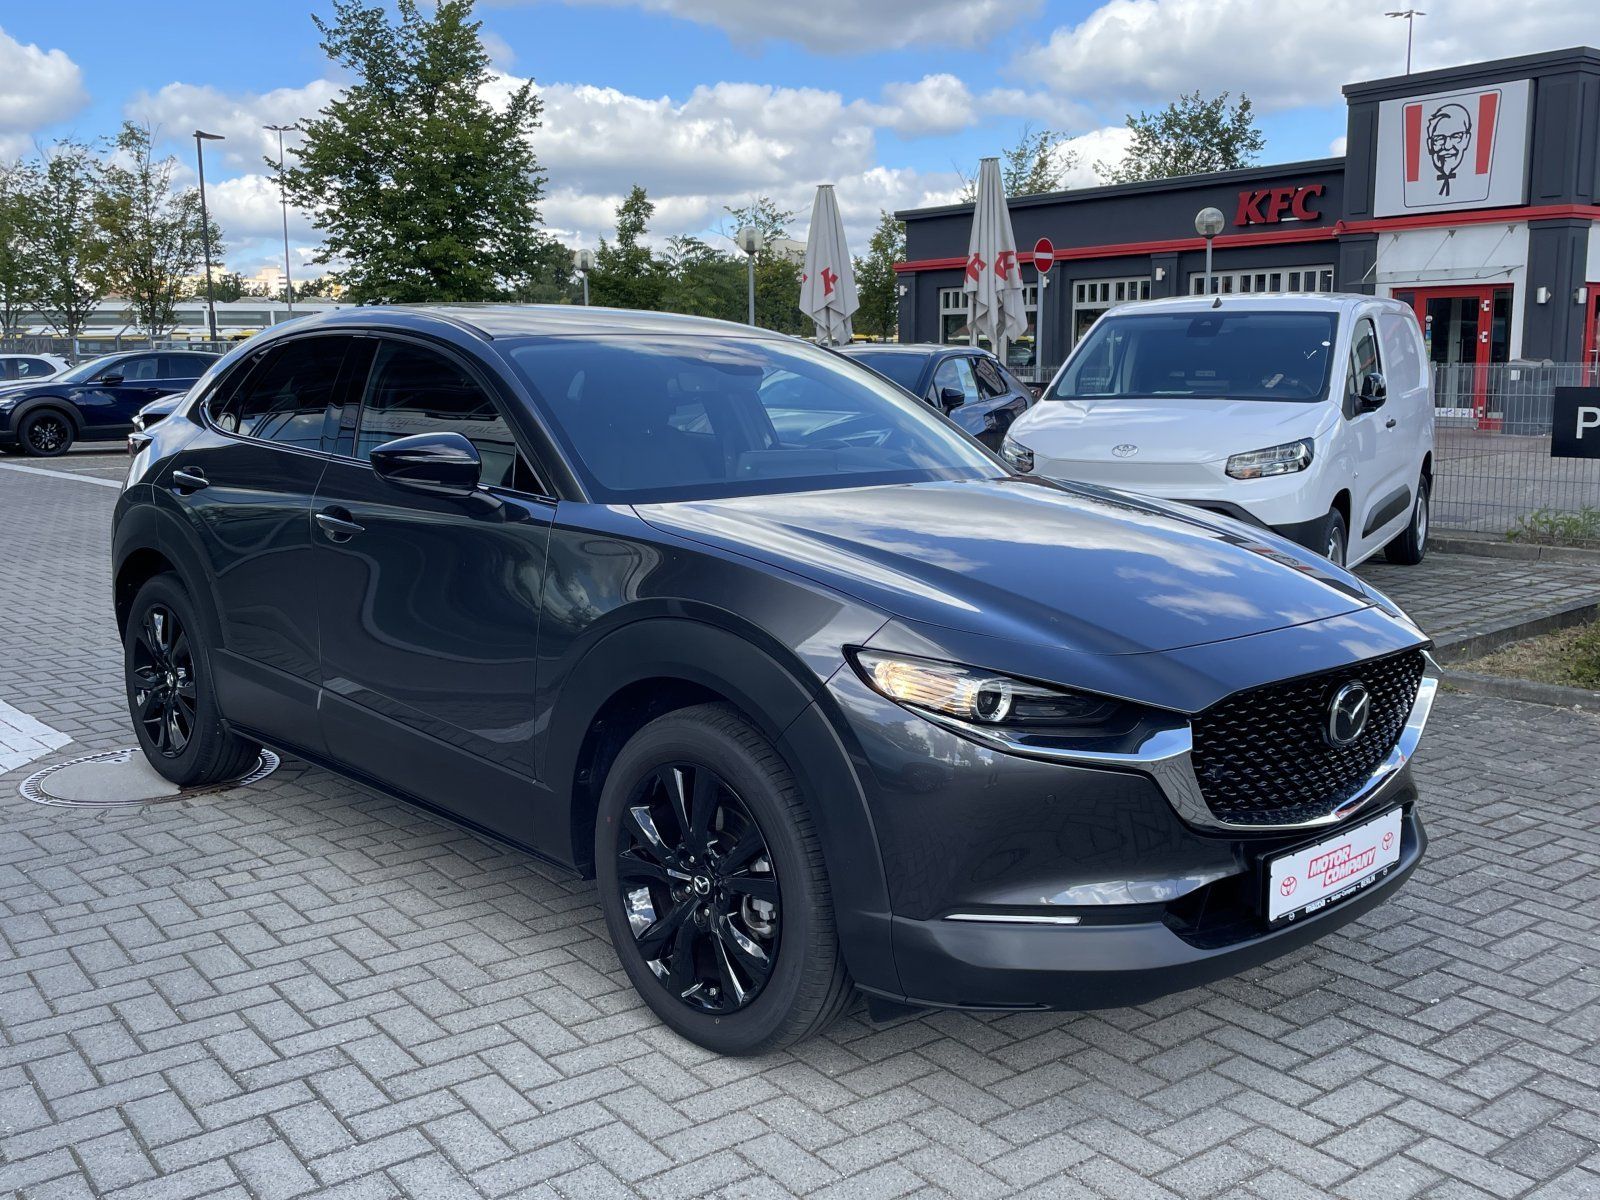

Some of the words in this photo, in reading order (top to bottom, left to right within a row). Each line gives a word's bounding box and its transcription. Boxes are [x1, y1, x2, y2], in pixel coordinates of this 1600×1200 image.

[1232, 184, 1323, 226] KFC
[1308, 845, 1351, 878] MOTOR
[1323, 847, 1376, 887] COMPANY
